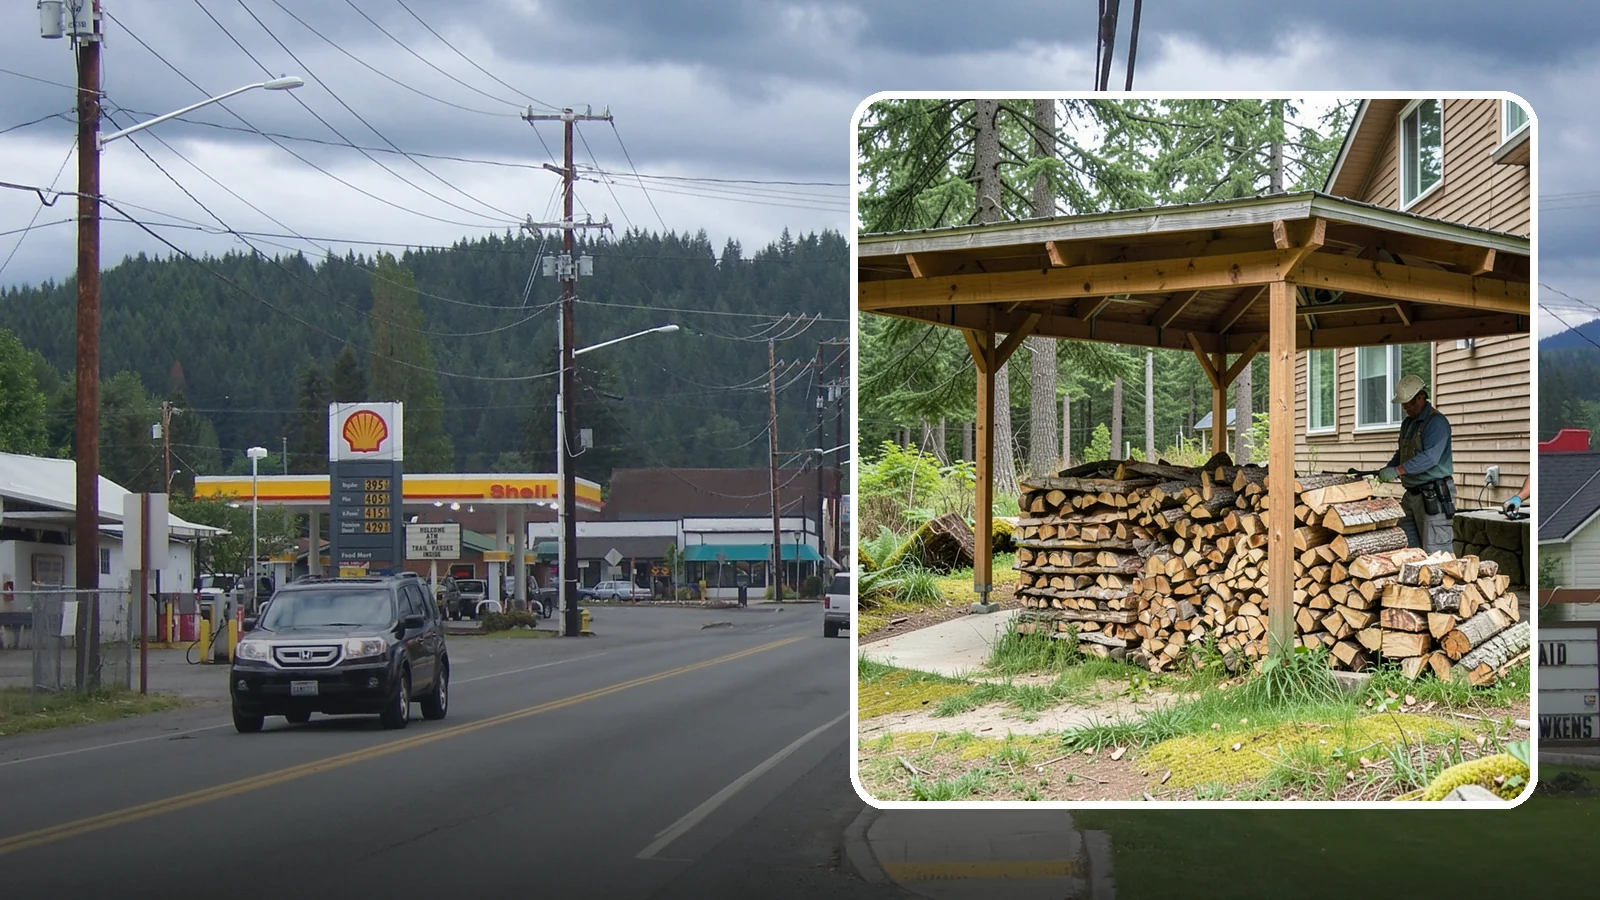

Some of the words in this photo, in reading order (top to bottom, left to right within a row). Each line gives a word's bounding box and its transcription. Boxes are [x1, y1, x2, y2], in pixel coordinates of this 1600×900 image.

[366, 480, 383, 490] 395
[490, 484, 547, 499] Shell
[366, 494, 383, 504] 405
[366, 508, 383, 518] 415
[366, 522, 383, 532] 429
